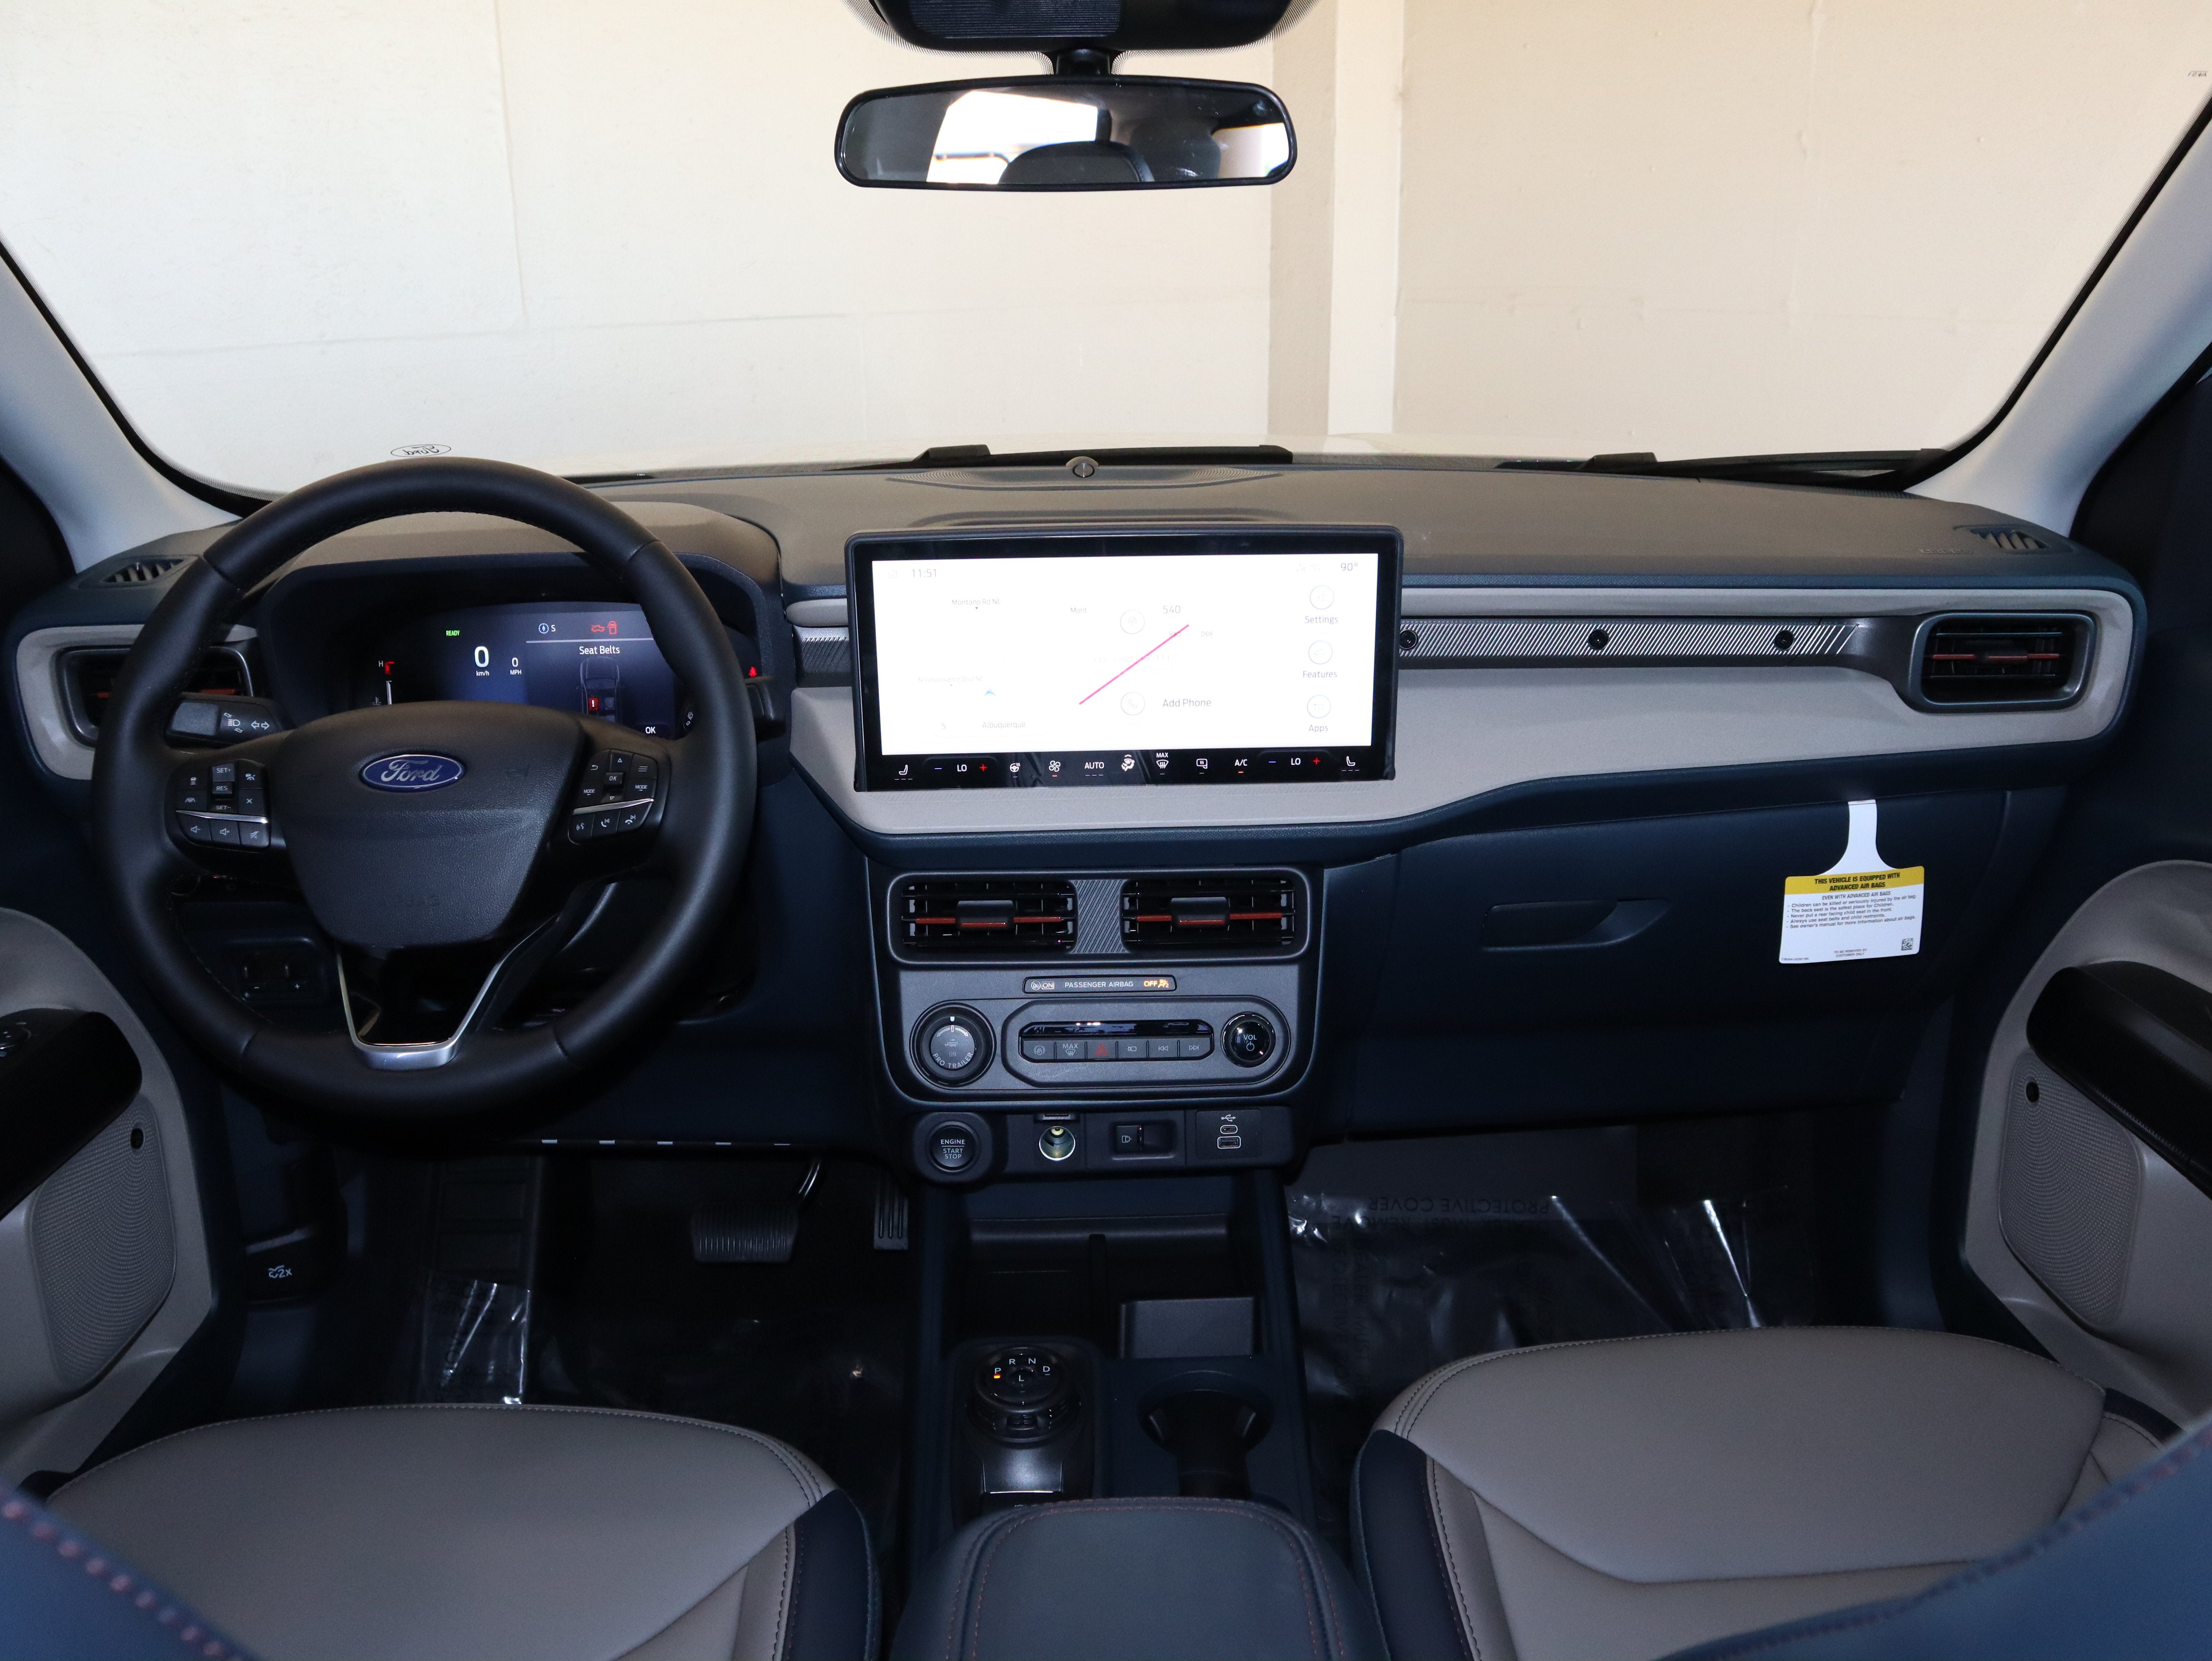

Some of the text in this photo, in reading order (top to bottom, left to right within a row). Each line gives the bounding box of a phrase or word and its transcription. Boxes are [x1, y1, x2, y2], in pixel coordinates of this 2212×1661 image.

[1341, 563, 1358, 571] 90°
[911, 568, 937, 578] 11:51
[1163, 605, 1181, 614] 540
[1305, 615, 1338, 625] Settings
[579, 645, 620, 654] Seat Belts
[475, 646, 489, 668] 0
[512, 657, 519, 667] 0
[1163, 698, 1211, 707] Add Phone
[982, 720, 1026, 730] Albuquerque
[1308, 724, 1329, 733] Apps
[381, 759, 443, 782] Ford
[932, 1052, 973, 1069] PRO TRAILER
[1368, 1196, 1549, 1214] PROTECTIVE COVER
